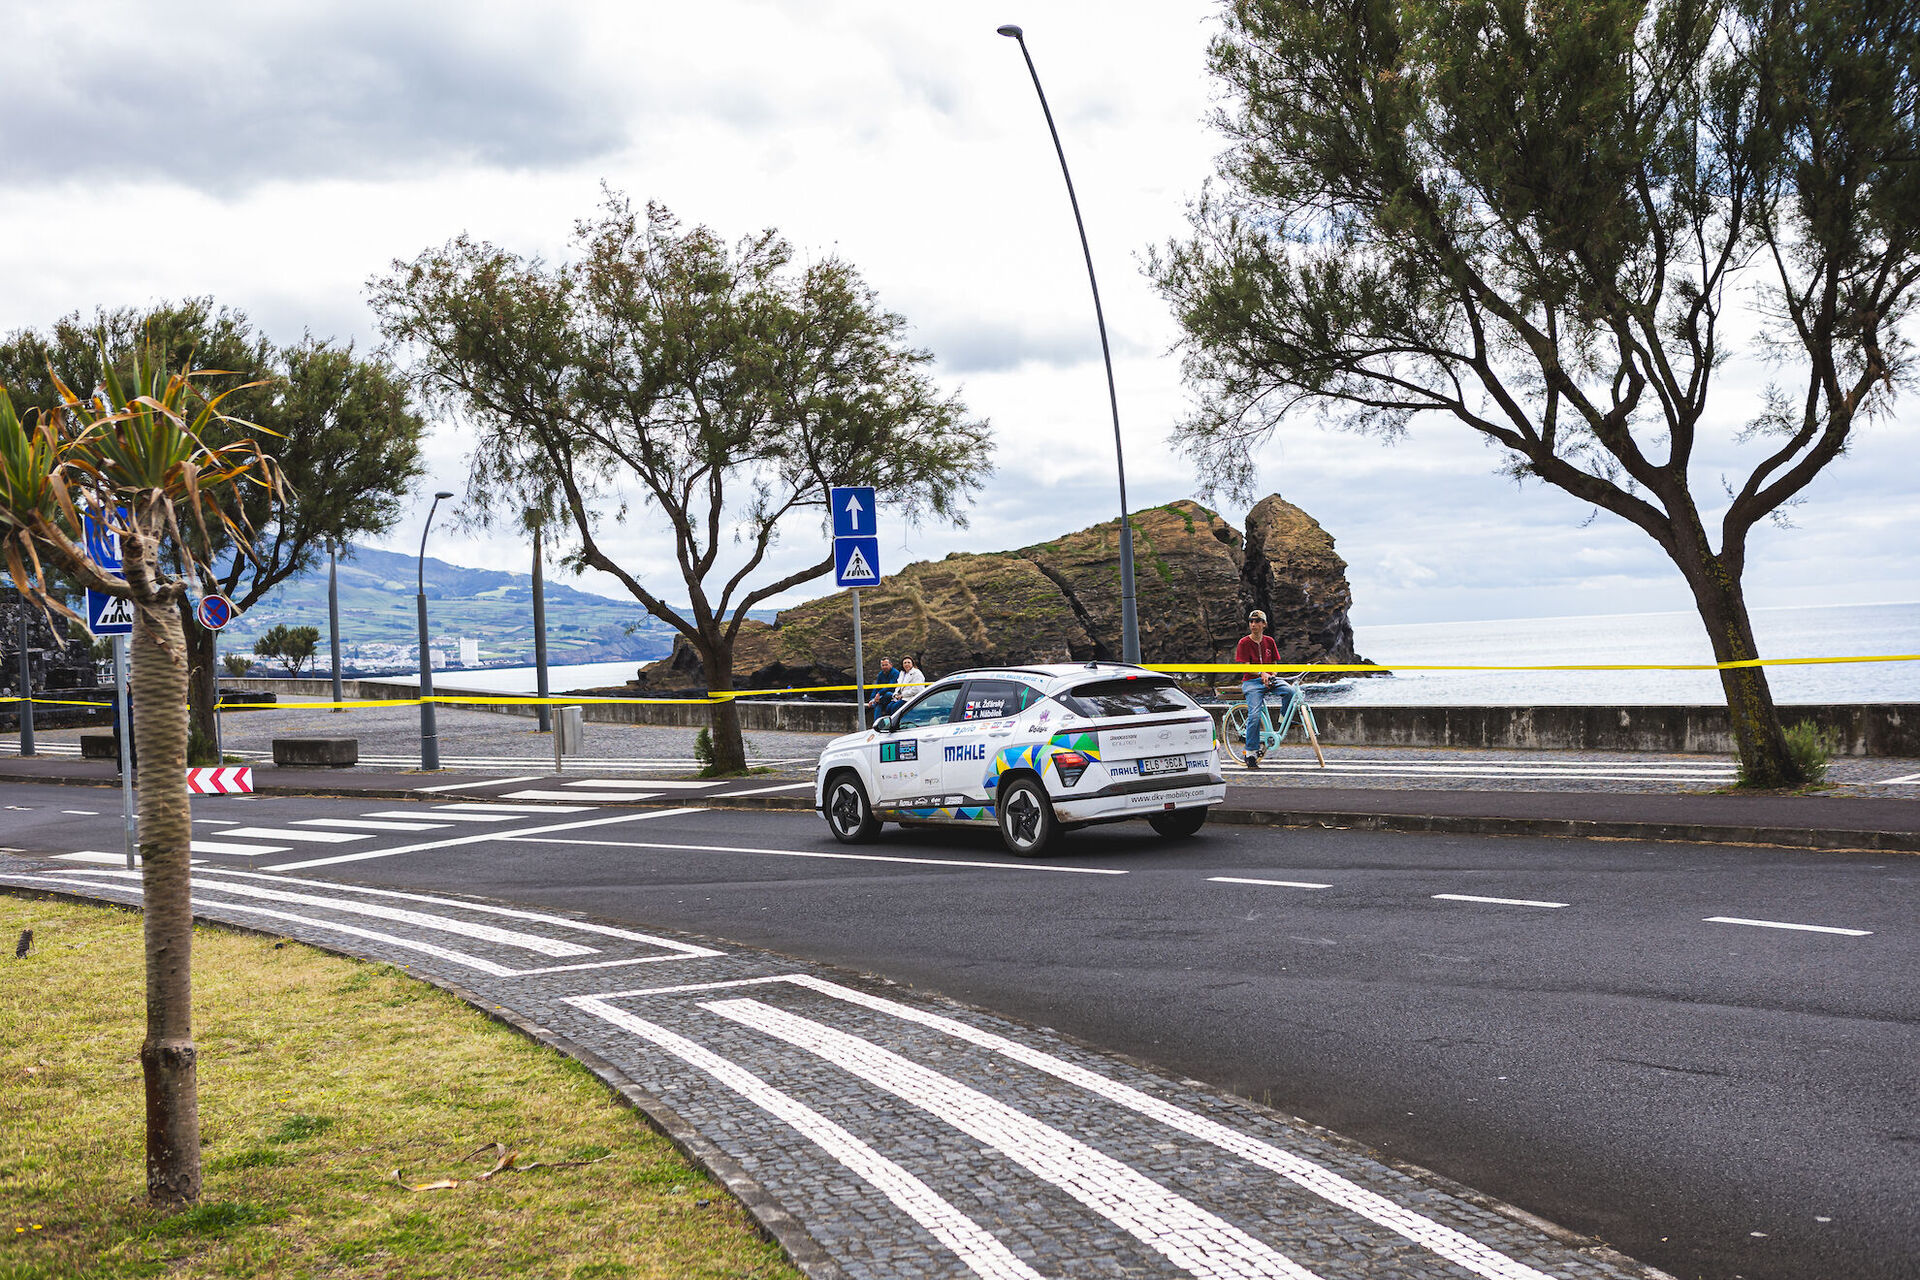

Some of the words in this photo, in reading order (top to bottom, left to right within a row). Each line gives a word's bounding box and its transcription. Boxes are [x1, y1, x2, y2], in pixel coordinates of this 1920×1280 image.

[1020, 687, 1030, 710] 1
[944, 744, 985, 762] MAHLE
[1145, 760, 1160, 771] EL6
[1163, 758, 1183, 769] 36CA
[1187, 759, 1209, 769] MAHLE
[1110, 766, 1138, 776] MAHLE
[1131, 789, 1205, 803] www.dkv-mobility.com
